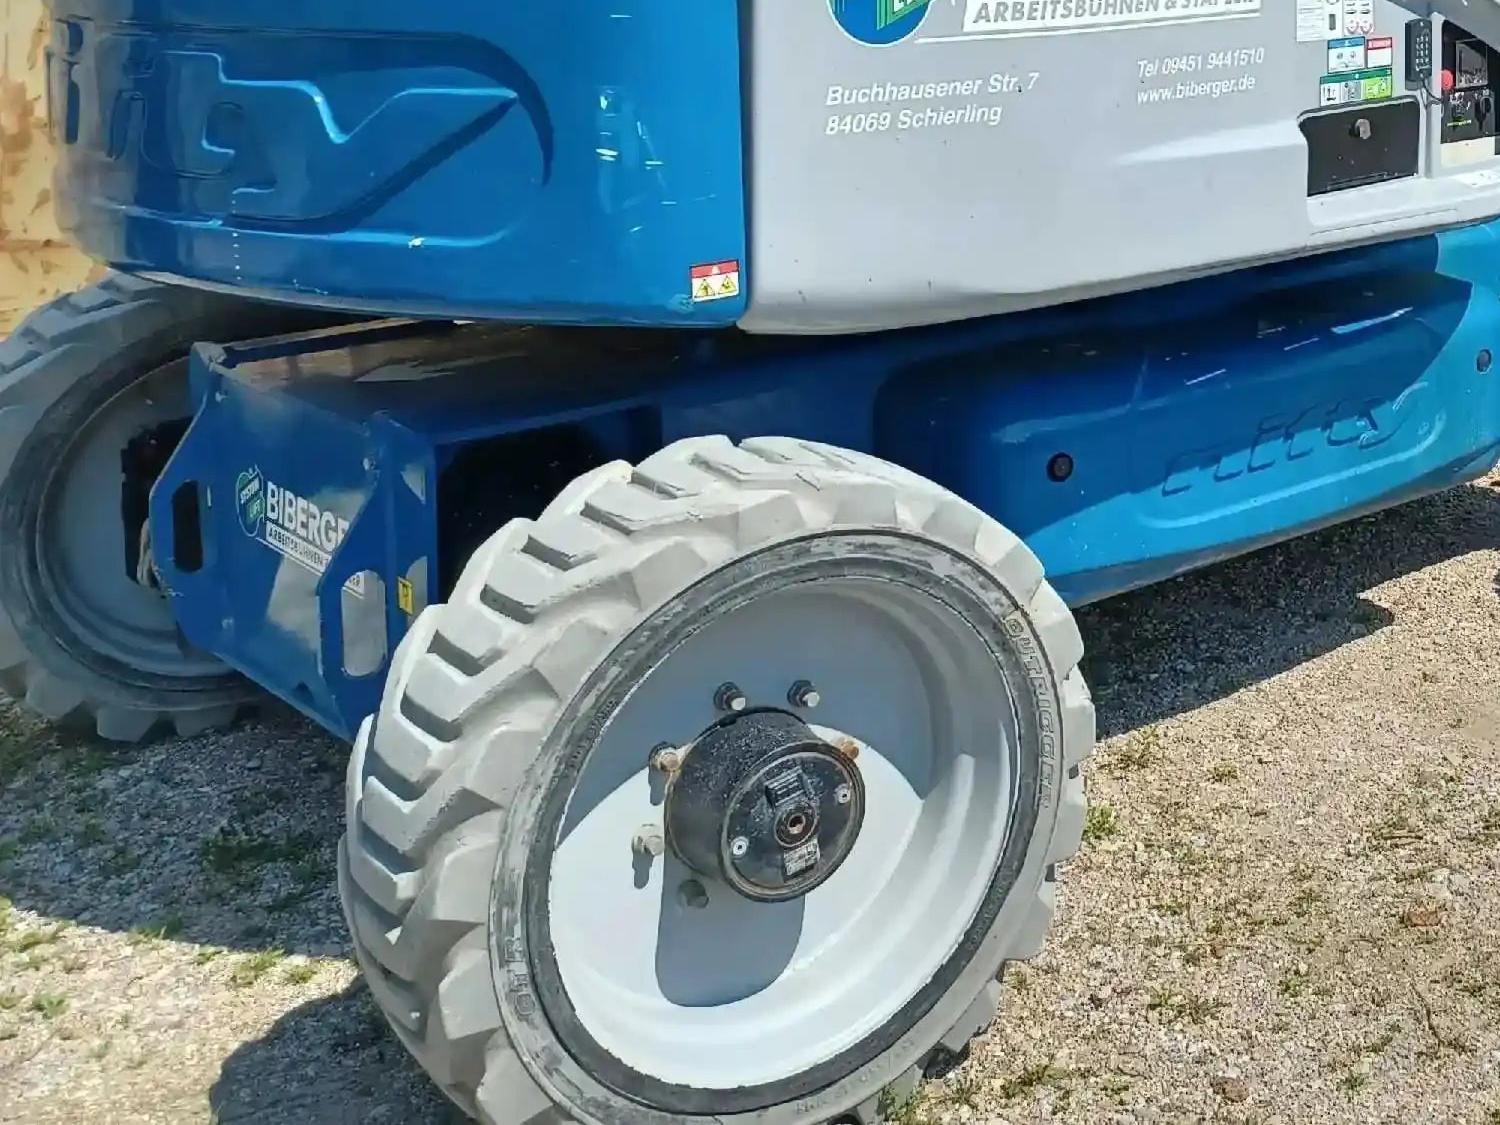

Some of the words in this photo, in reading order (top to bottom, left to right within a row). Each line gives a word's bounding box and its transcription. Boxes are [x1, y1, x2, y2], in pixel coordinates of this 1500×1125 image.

[1137, 59, 1159, 78] Tel
[1162, 54, 1202, 74] 09451
[1207, 47, 1265, 69] 9441510
[825, 78, 983, 106] Buchhausener
[987, 72, 1022, 93] Str.
[1027, 71, 1040, 90] 7
[1137, 74, 1256, 104] www.biberger.de
[824, 111, 891, 135] 84069
[897, 104, 1003, 129] Schierling
[267, 481, 350, 553] BIBERG
